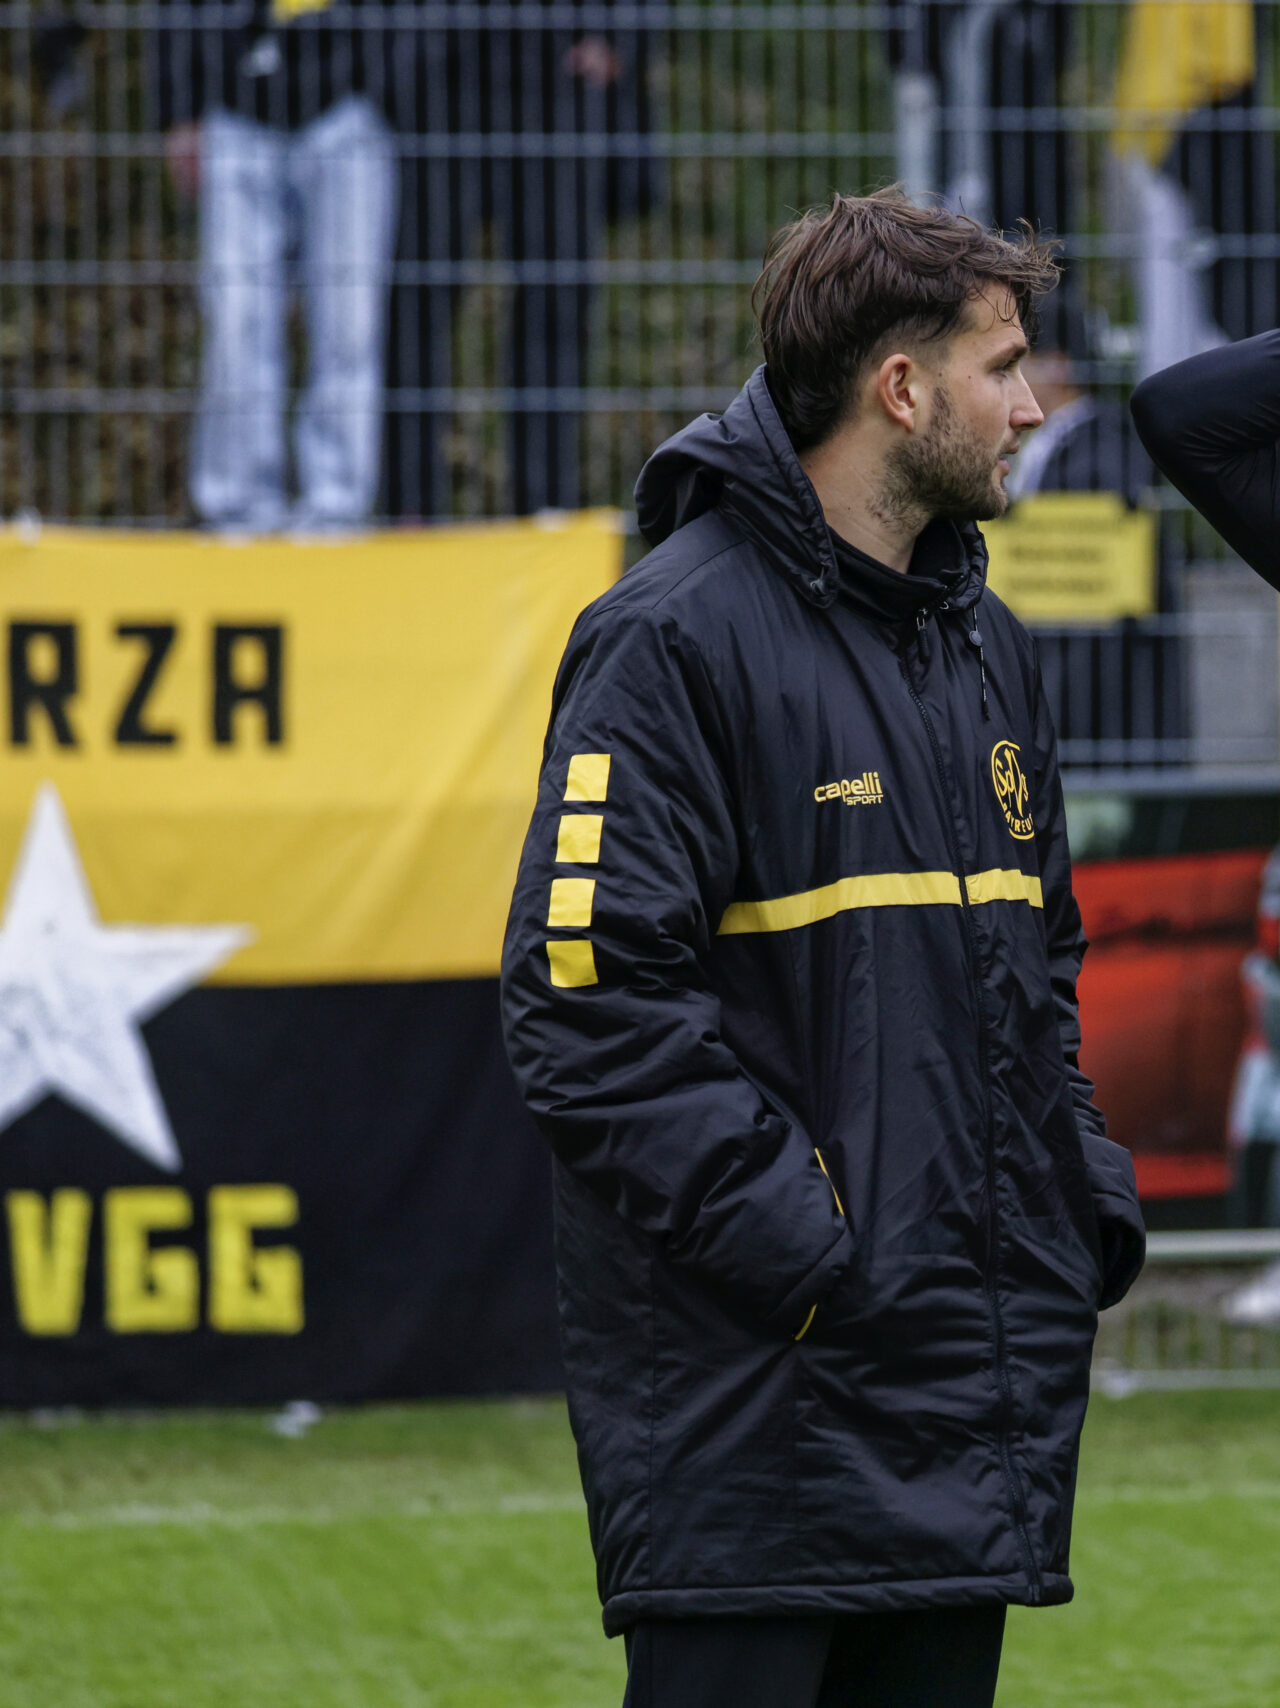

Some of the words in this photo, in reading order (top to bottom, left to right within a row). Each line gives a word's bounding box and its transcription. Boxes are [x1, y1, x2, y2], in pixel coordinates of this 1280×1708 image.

[7, 619, 287, 750] RZA
[814, 772, 883, 803] capelli
[847, 795, 884, 806] SPORT
